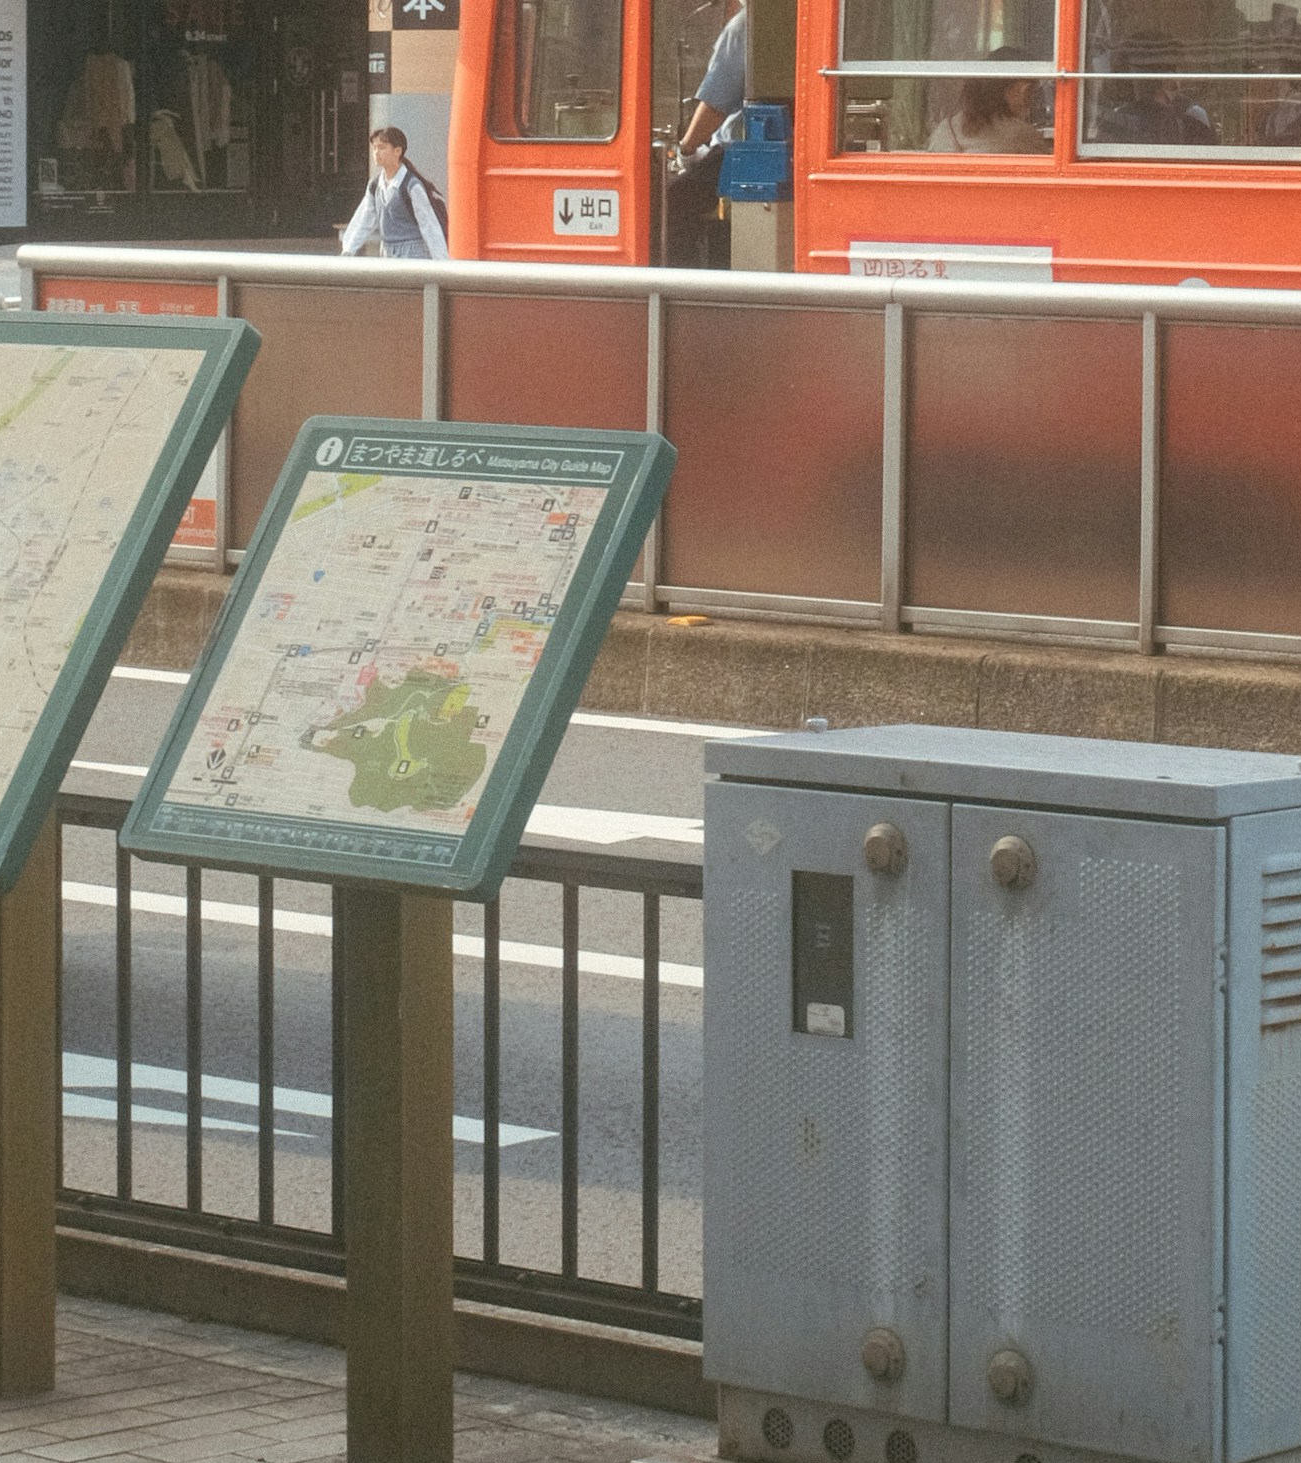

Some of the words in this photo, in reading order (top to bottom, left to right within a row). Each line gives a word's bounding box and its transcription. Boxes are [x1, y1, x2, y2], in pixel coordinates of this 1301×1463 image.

[581, 196, 611, 218] 出口
[350, 445, 483, 469] まつやま道しるべ
[487, 455, 540, 470] Matsuyama
[542, 458, 558, 473] City
[559, 459, 588, 473] Guide
[590, 461, 611, 476] Map
